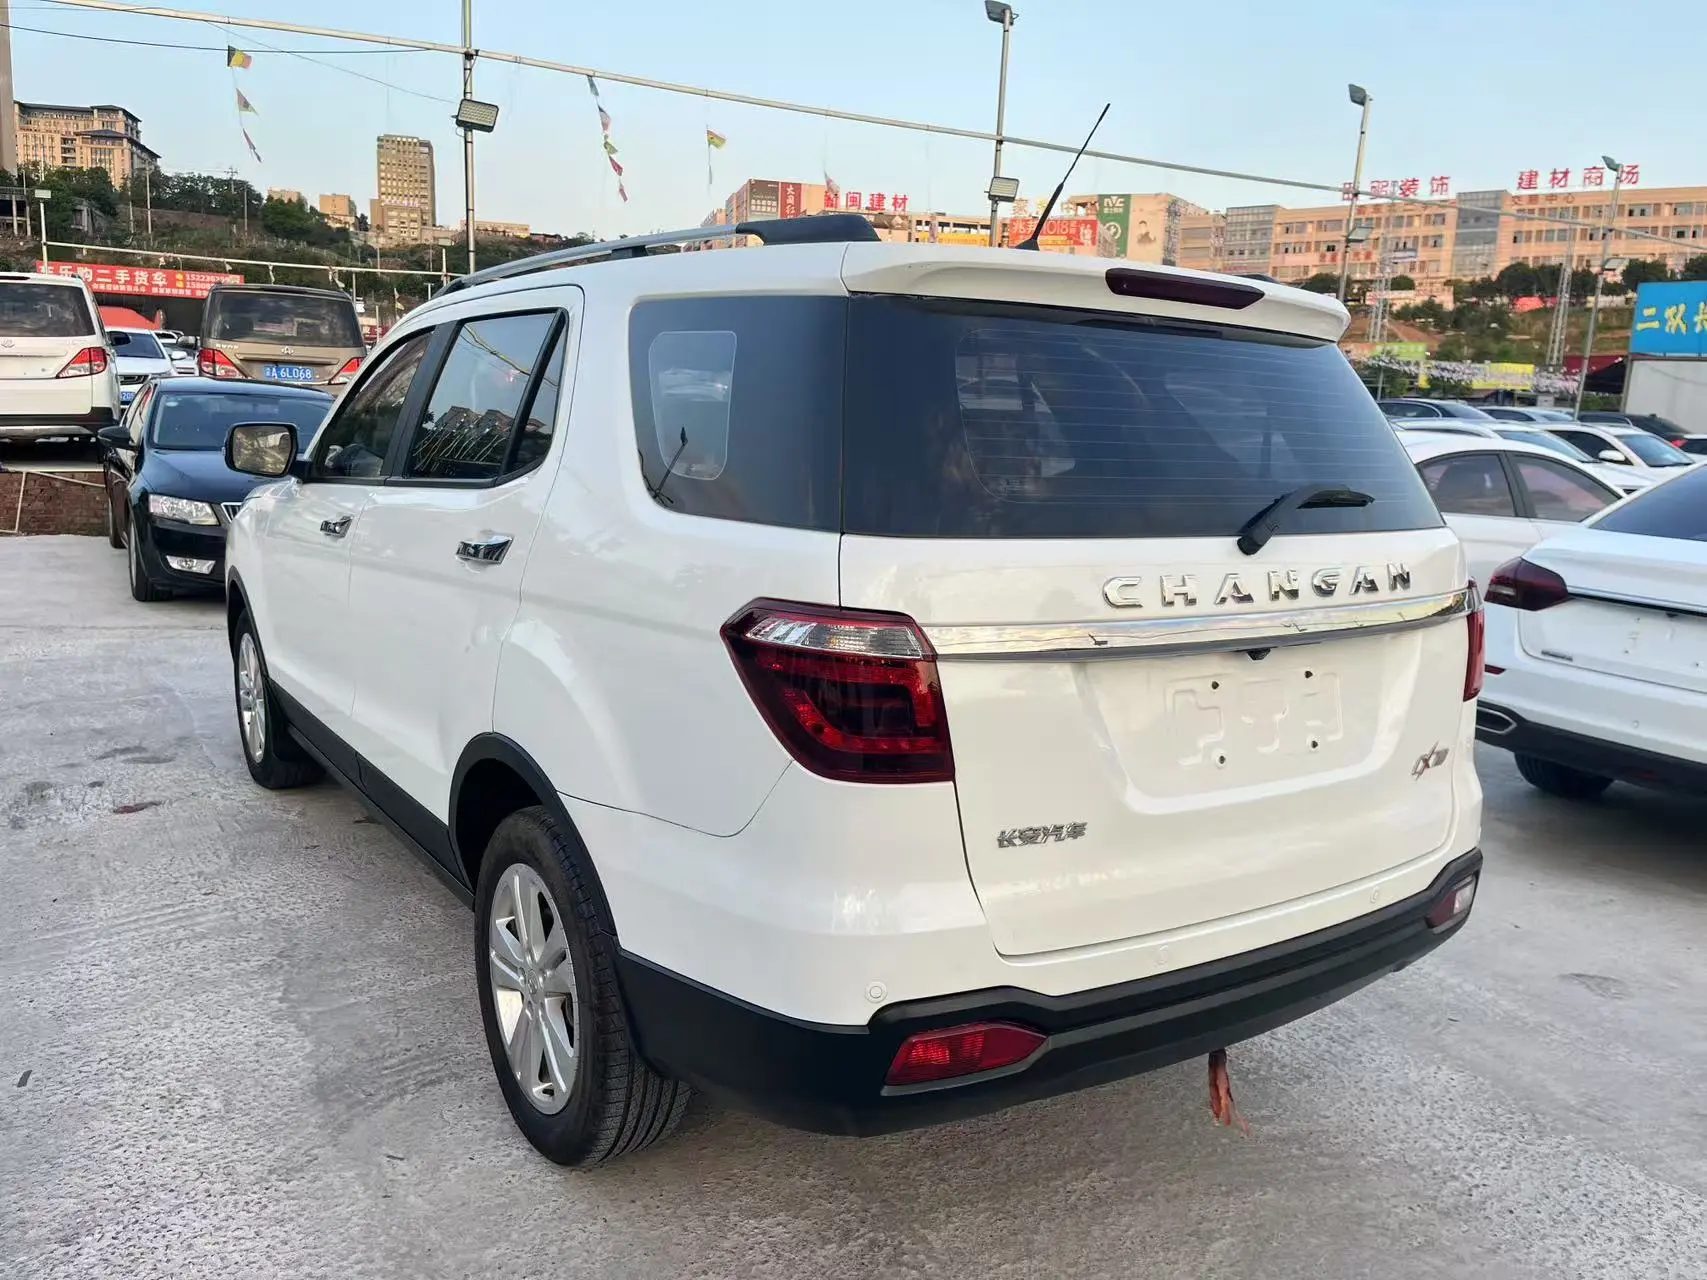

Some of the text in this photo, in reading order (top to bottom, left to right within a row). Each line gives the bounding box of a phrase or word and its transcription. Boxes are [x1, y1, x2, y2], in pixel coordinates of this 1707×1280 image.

[1518, 164, 1640, 190] 建材商场
[1102, 562, 1412, 608] CHANGAN
[997, 821, 1088, 848] 长安汽车
